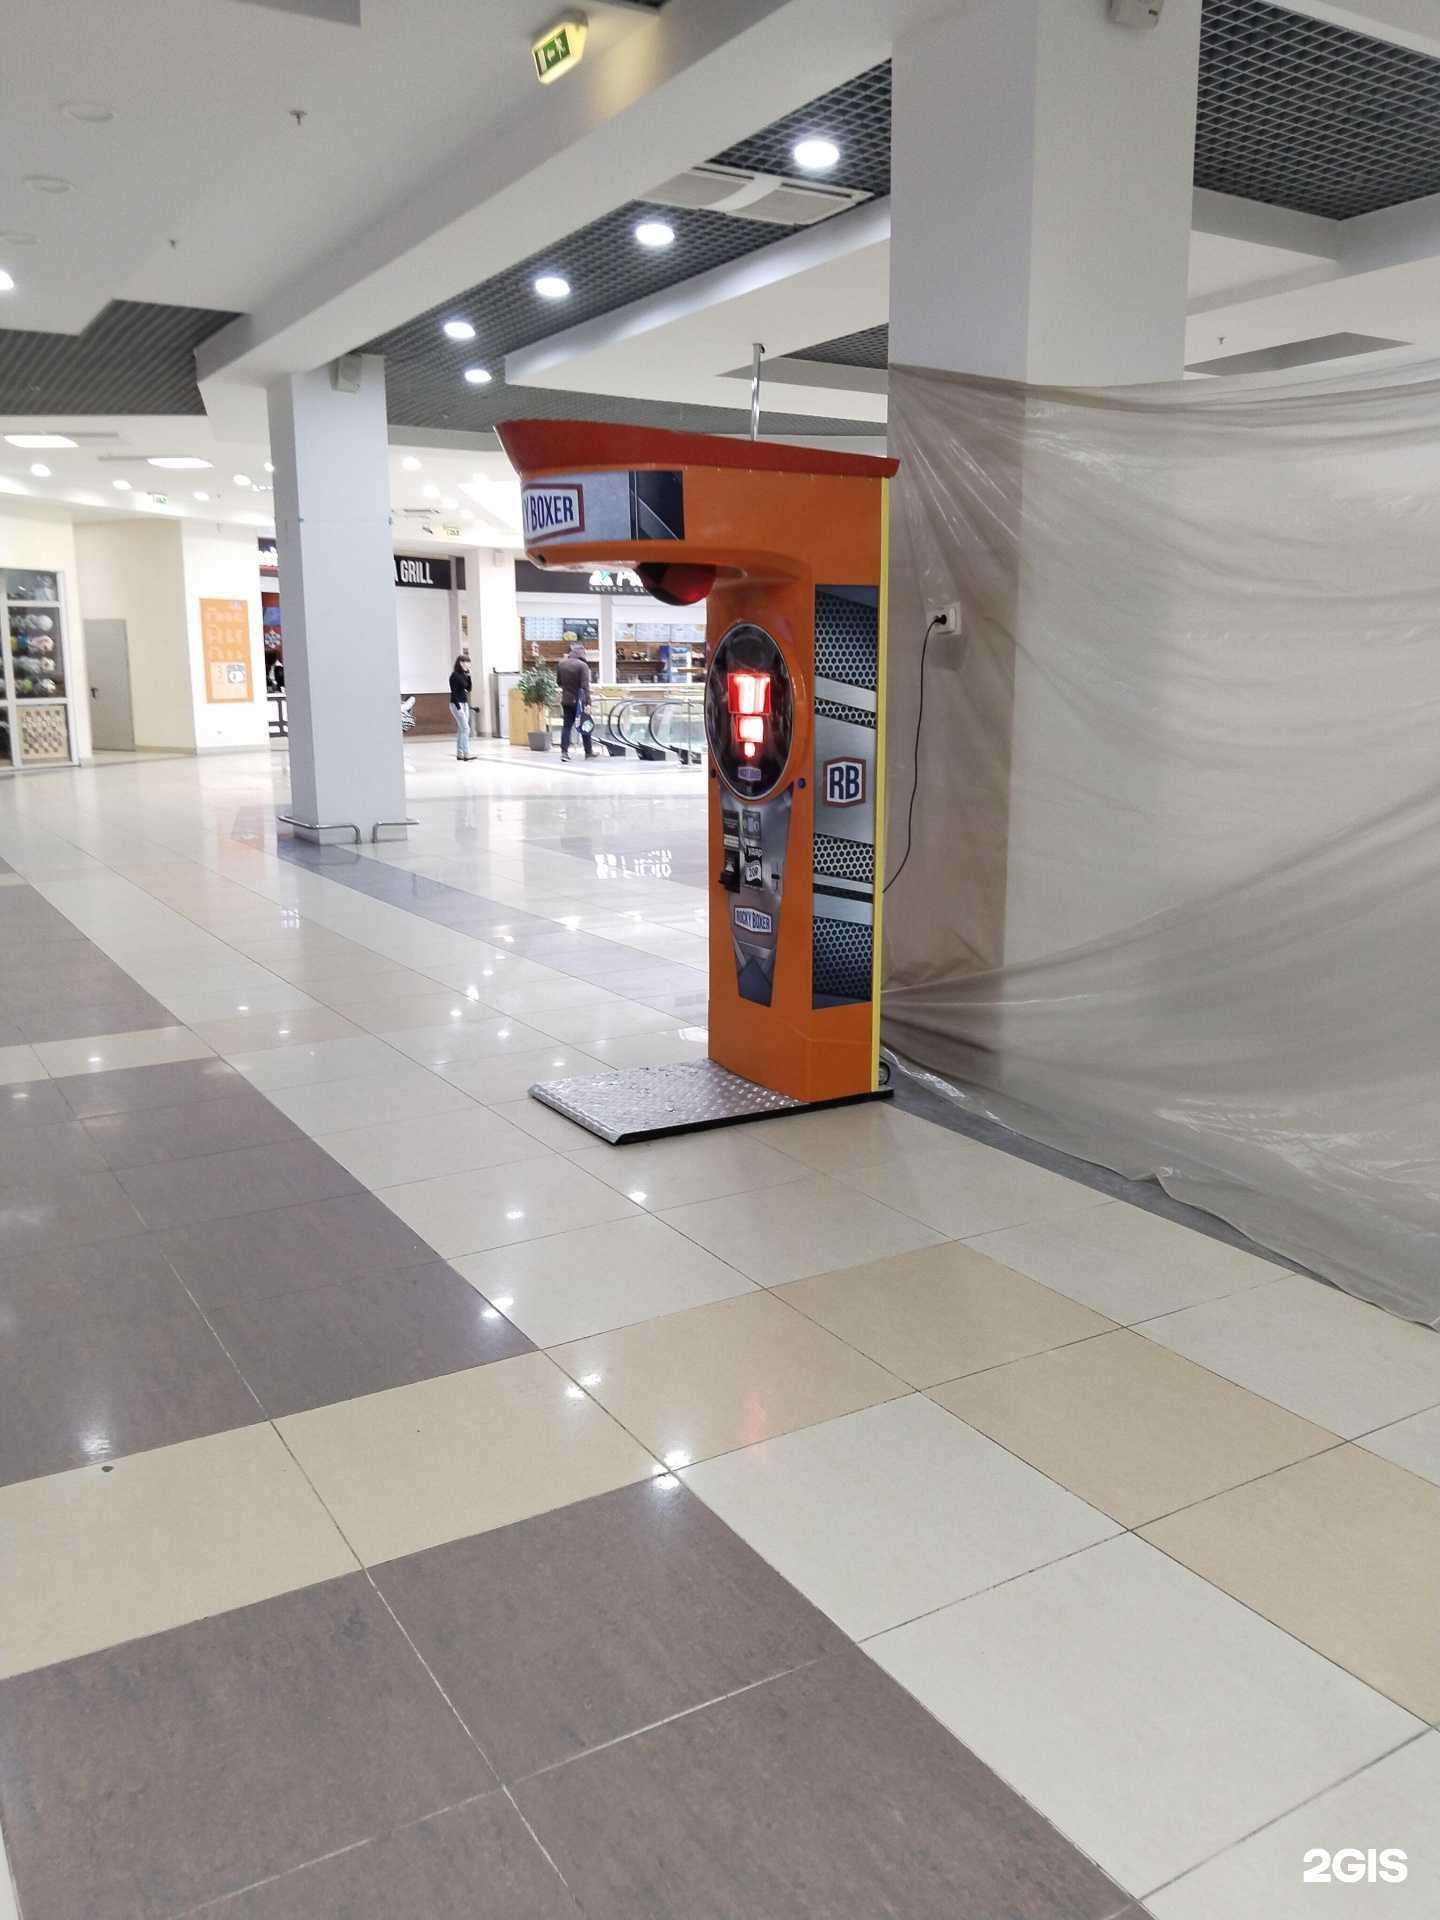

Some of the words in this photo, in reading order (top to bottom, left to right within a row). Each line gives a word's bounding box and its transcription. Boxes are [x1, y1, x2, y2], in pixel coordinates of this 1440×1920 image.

[533, 495, 574, 532] BOXER
[400, 560, 434, 585] GRILL
[829, 765, 860, 800] RB
